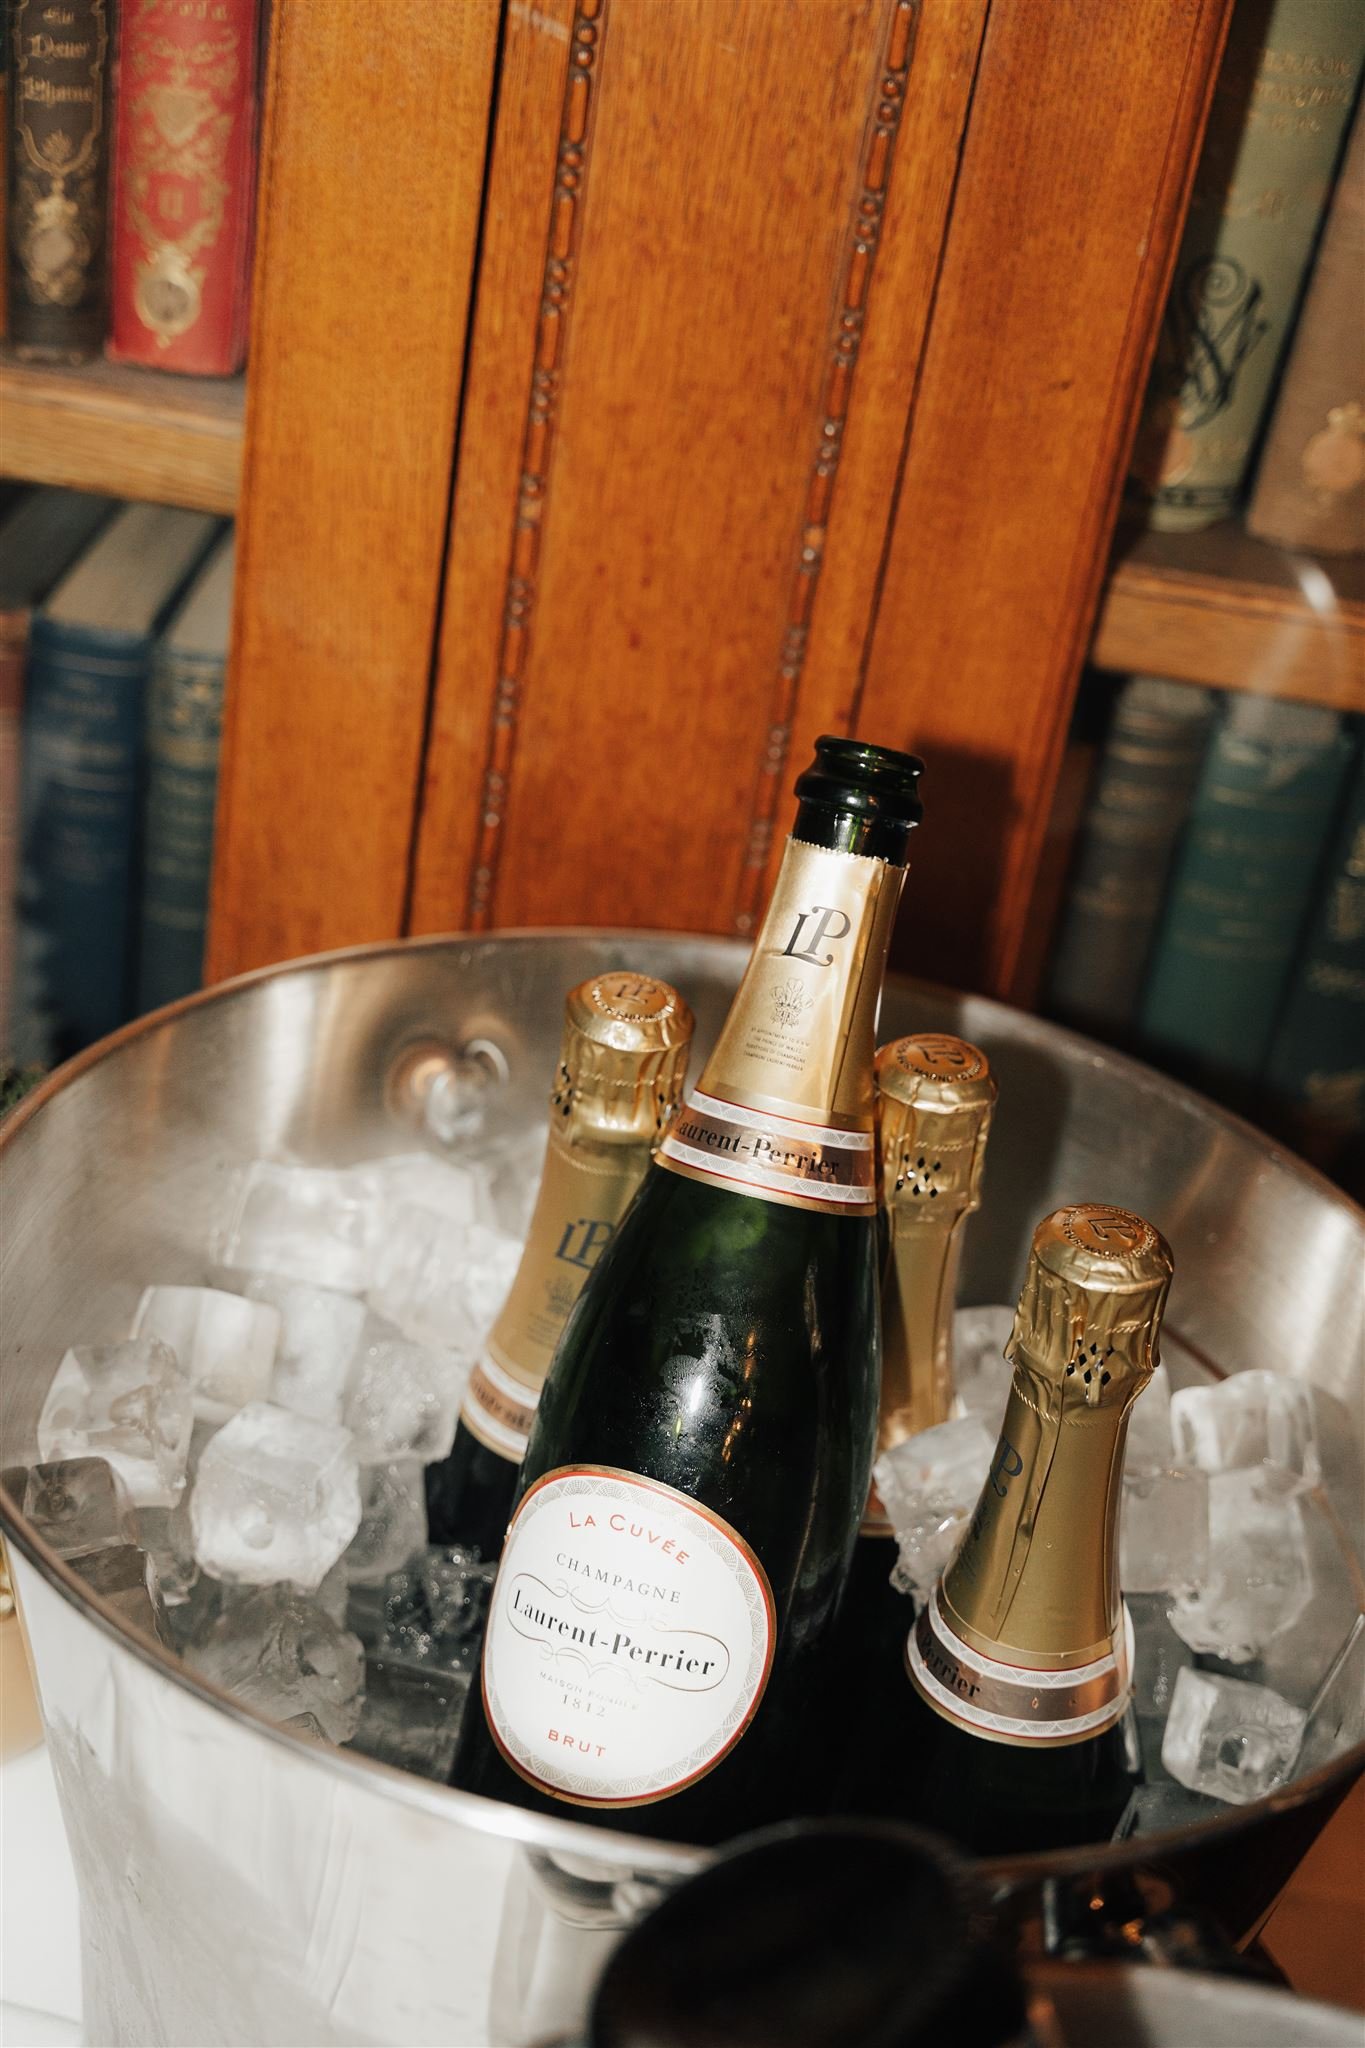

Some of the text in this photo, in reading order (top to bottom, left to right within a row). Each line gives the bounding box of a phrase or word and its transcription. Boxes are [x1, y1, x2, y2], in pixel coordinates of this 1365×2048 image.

[782, 906, 851, 967] LP
[676, 1120, 840, 1176] aurent-Perrier
[556, 1552, 681, 1604] CHAMPAGNE
[513, 1589, 716, 1676] Laurent-Perrier
[540, 1671, 583, 1694] MAISON
[563, 1694, 606, 1718] 1812
[547, 1728, 607, 1758] BRUT
